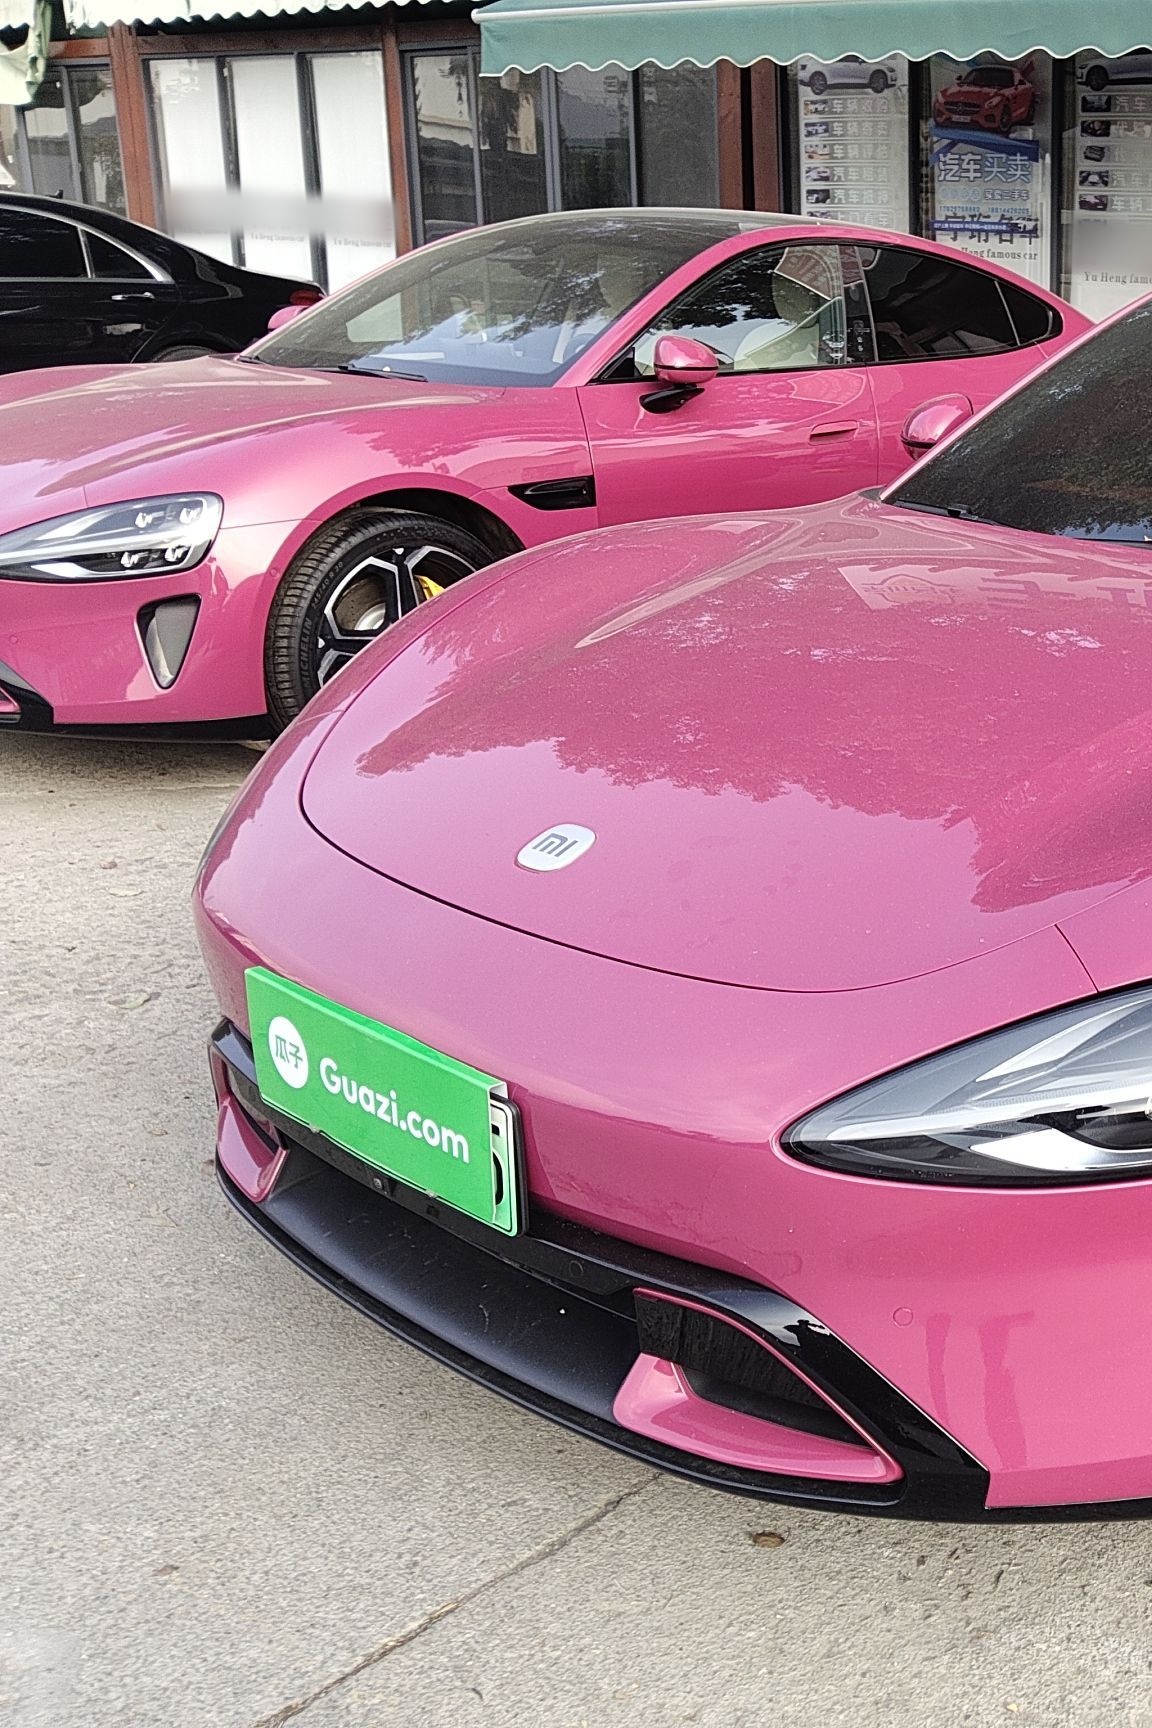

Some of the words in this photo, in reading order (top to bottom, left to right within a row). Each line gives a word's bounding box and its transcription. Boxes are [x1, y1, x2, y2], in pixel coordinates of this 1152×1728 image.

[938, 153, 1031, 182] 汽车买卖
[987, 249, 1020, 260] famous
[1023, 251, 1038, 260] car
[1084, 271, 1098, 281] Yu
[1101, 272, 1127, 285] Heng
[299, 617, 313, 689] MICHELIN
[273, 1034, 304, 1070] 瓜子
[319, 1057, 470, 1164] Guazi.com
